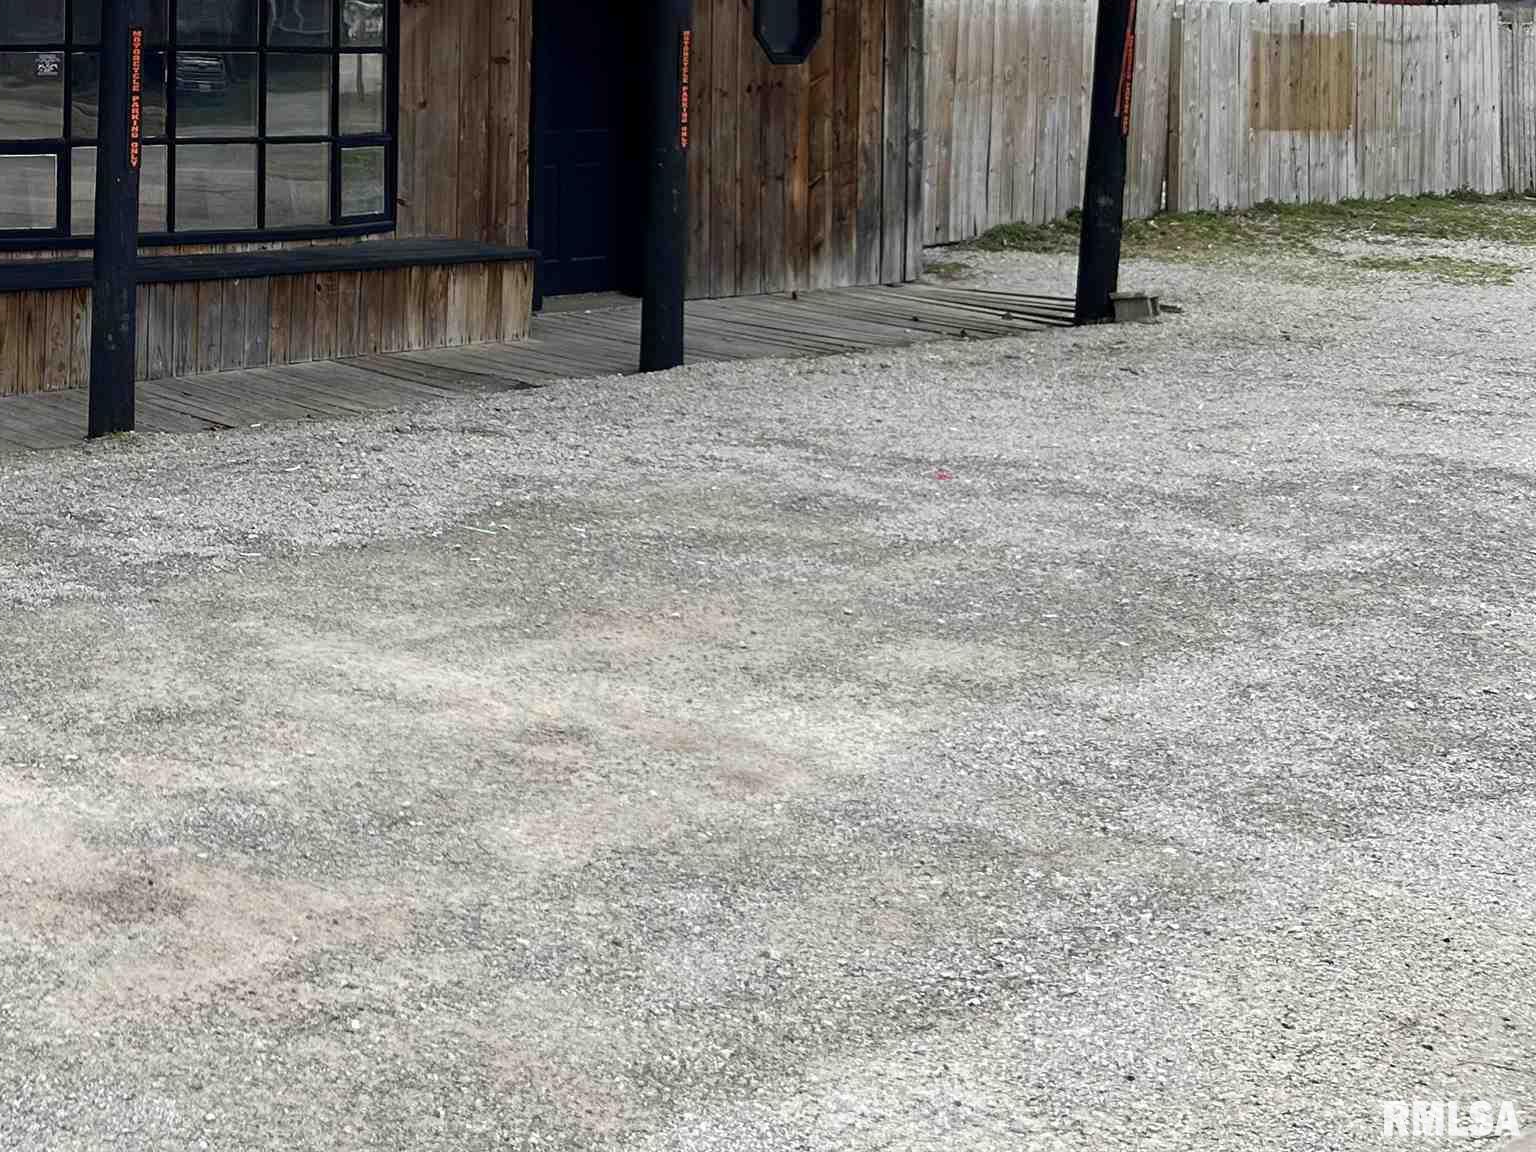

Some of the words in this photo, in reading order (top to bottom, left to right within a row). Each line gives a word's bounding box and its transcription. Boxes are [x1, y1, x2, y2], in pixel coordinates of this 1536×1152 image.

[132, 30, 143, 92] MOTORCYCLE
[131, 96, 140, 138] PARKING
[130, 142, 139, 168] ONLY
